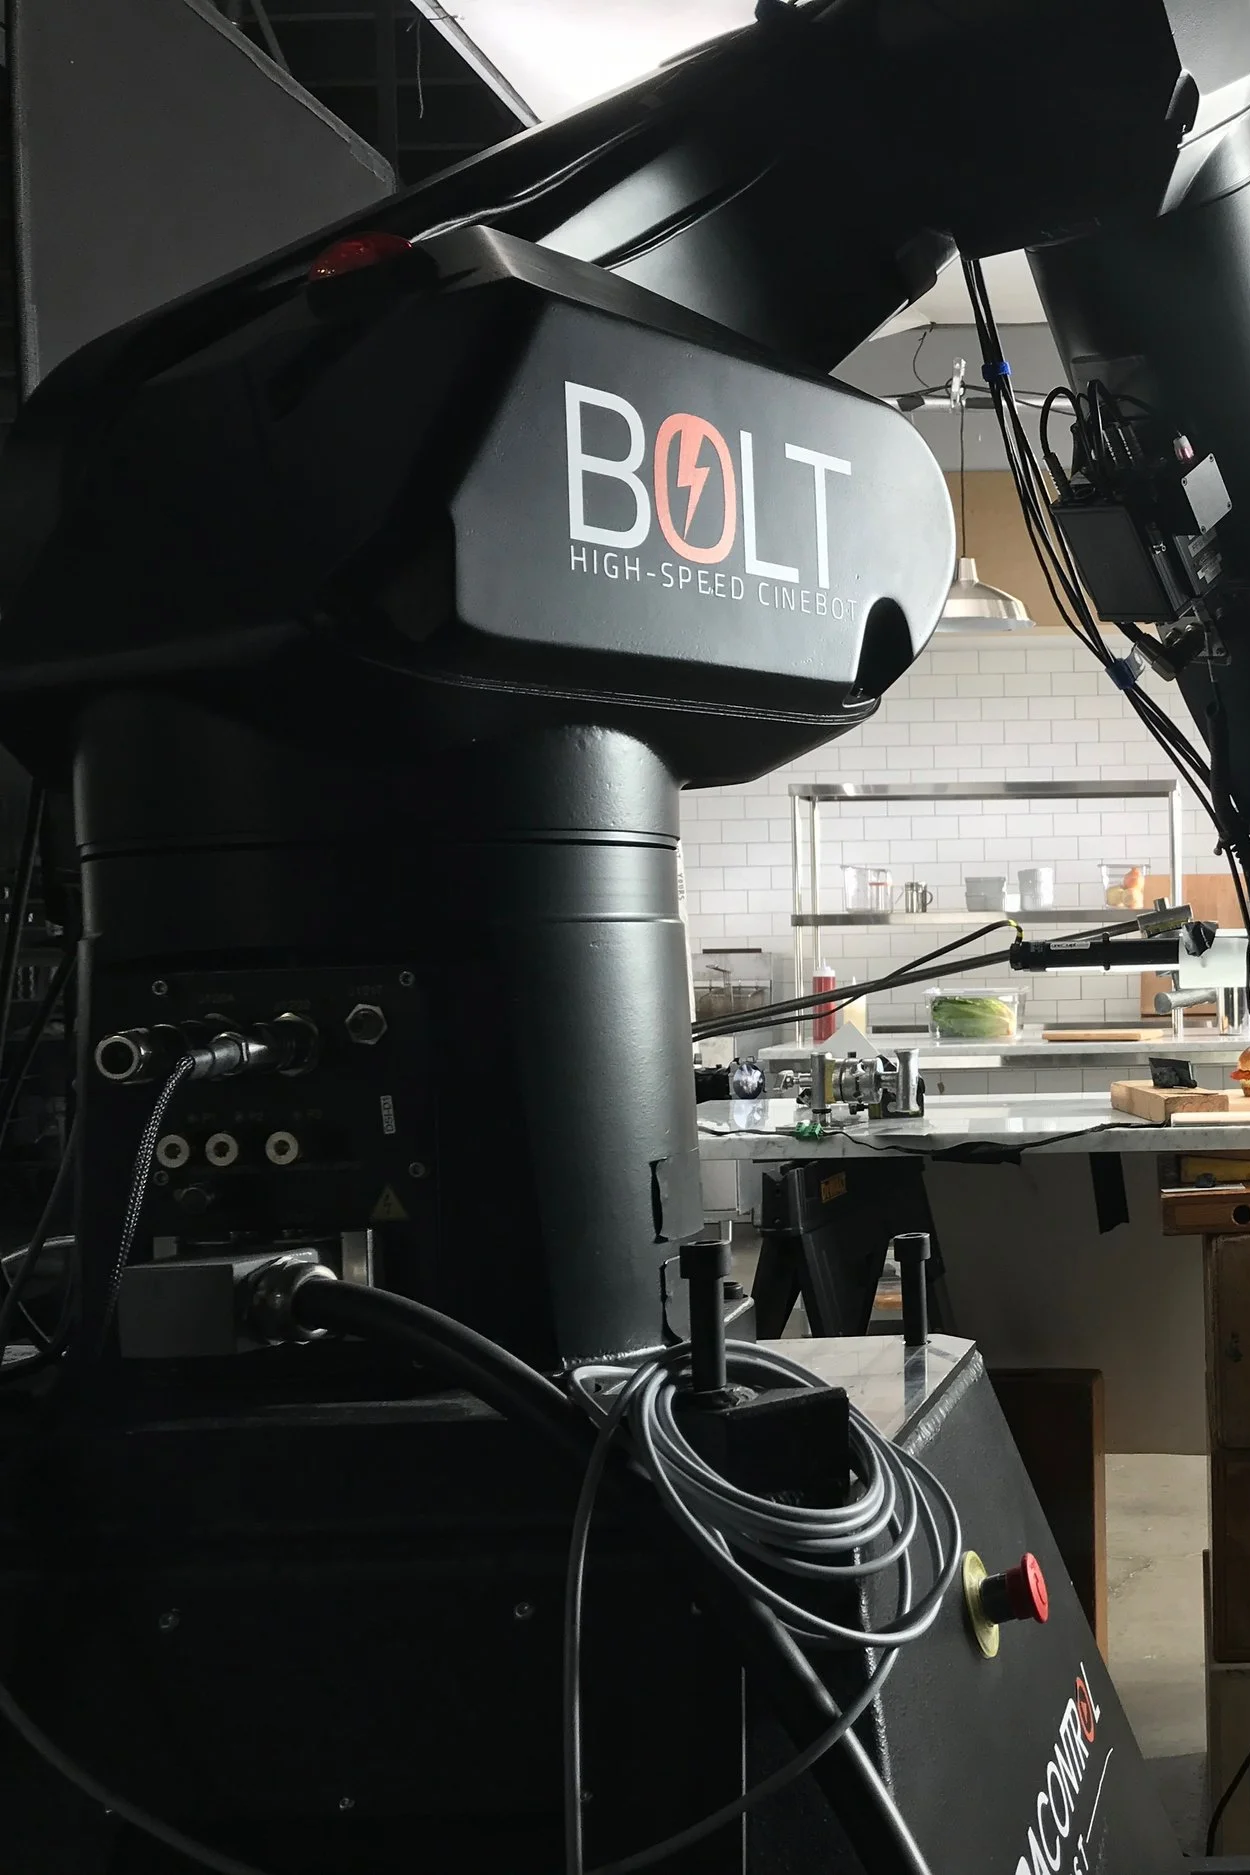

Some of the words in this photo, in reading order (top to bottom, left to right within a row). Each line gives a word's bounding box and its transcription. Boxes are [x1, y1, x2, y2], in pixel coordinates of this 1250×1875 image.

[564, 381, 851, 588] BOLT
[570, 545, 745, 600] HIGH-SPEED
[758, 582, 858, 620] CINEBOT
